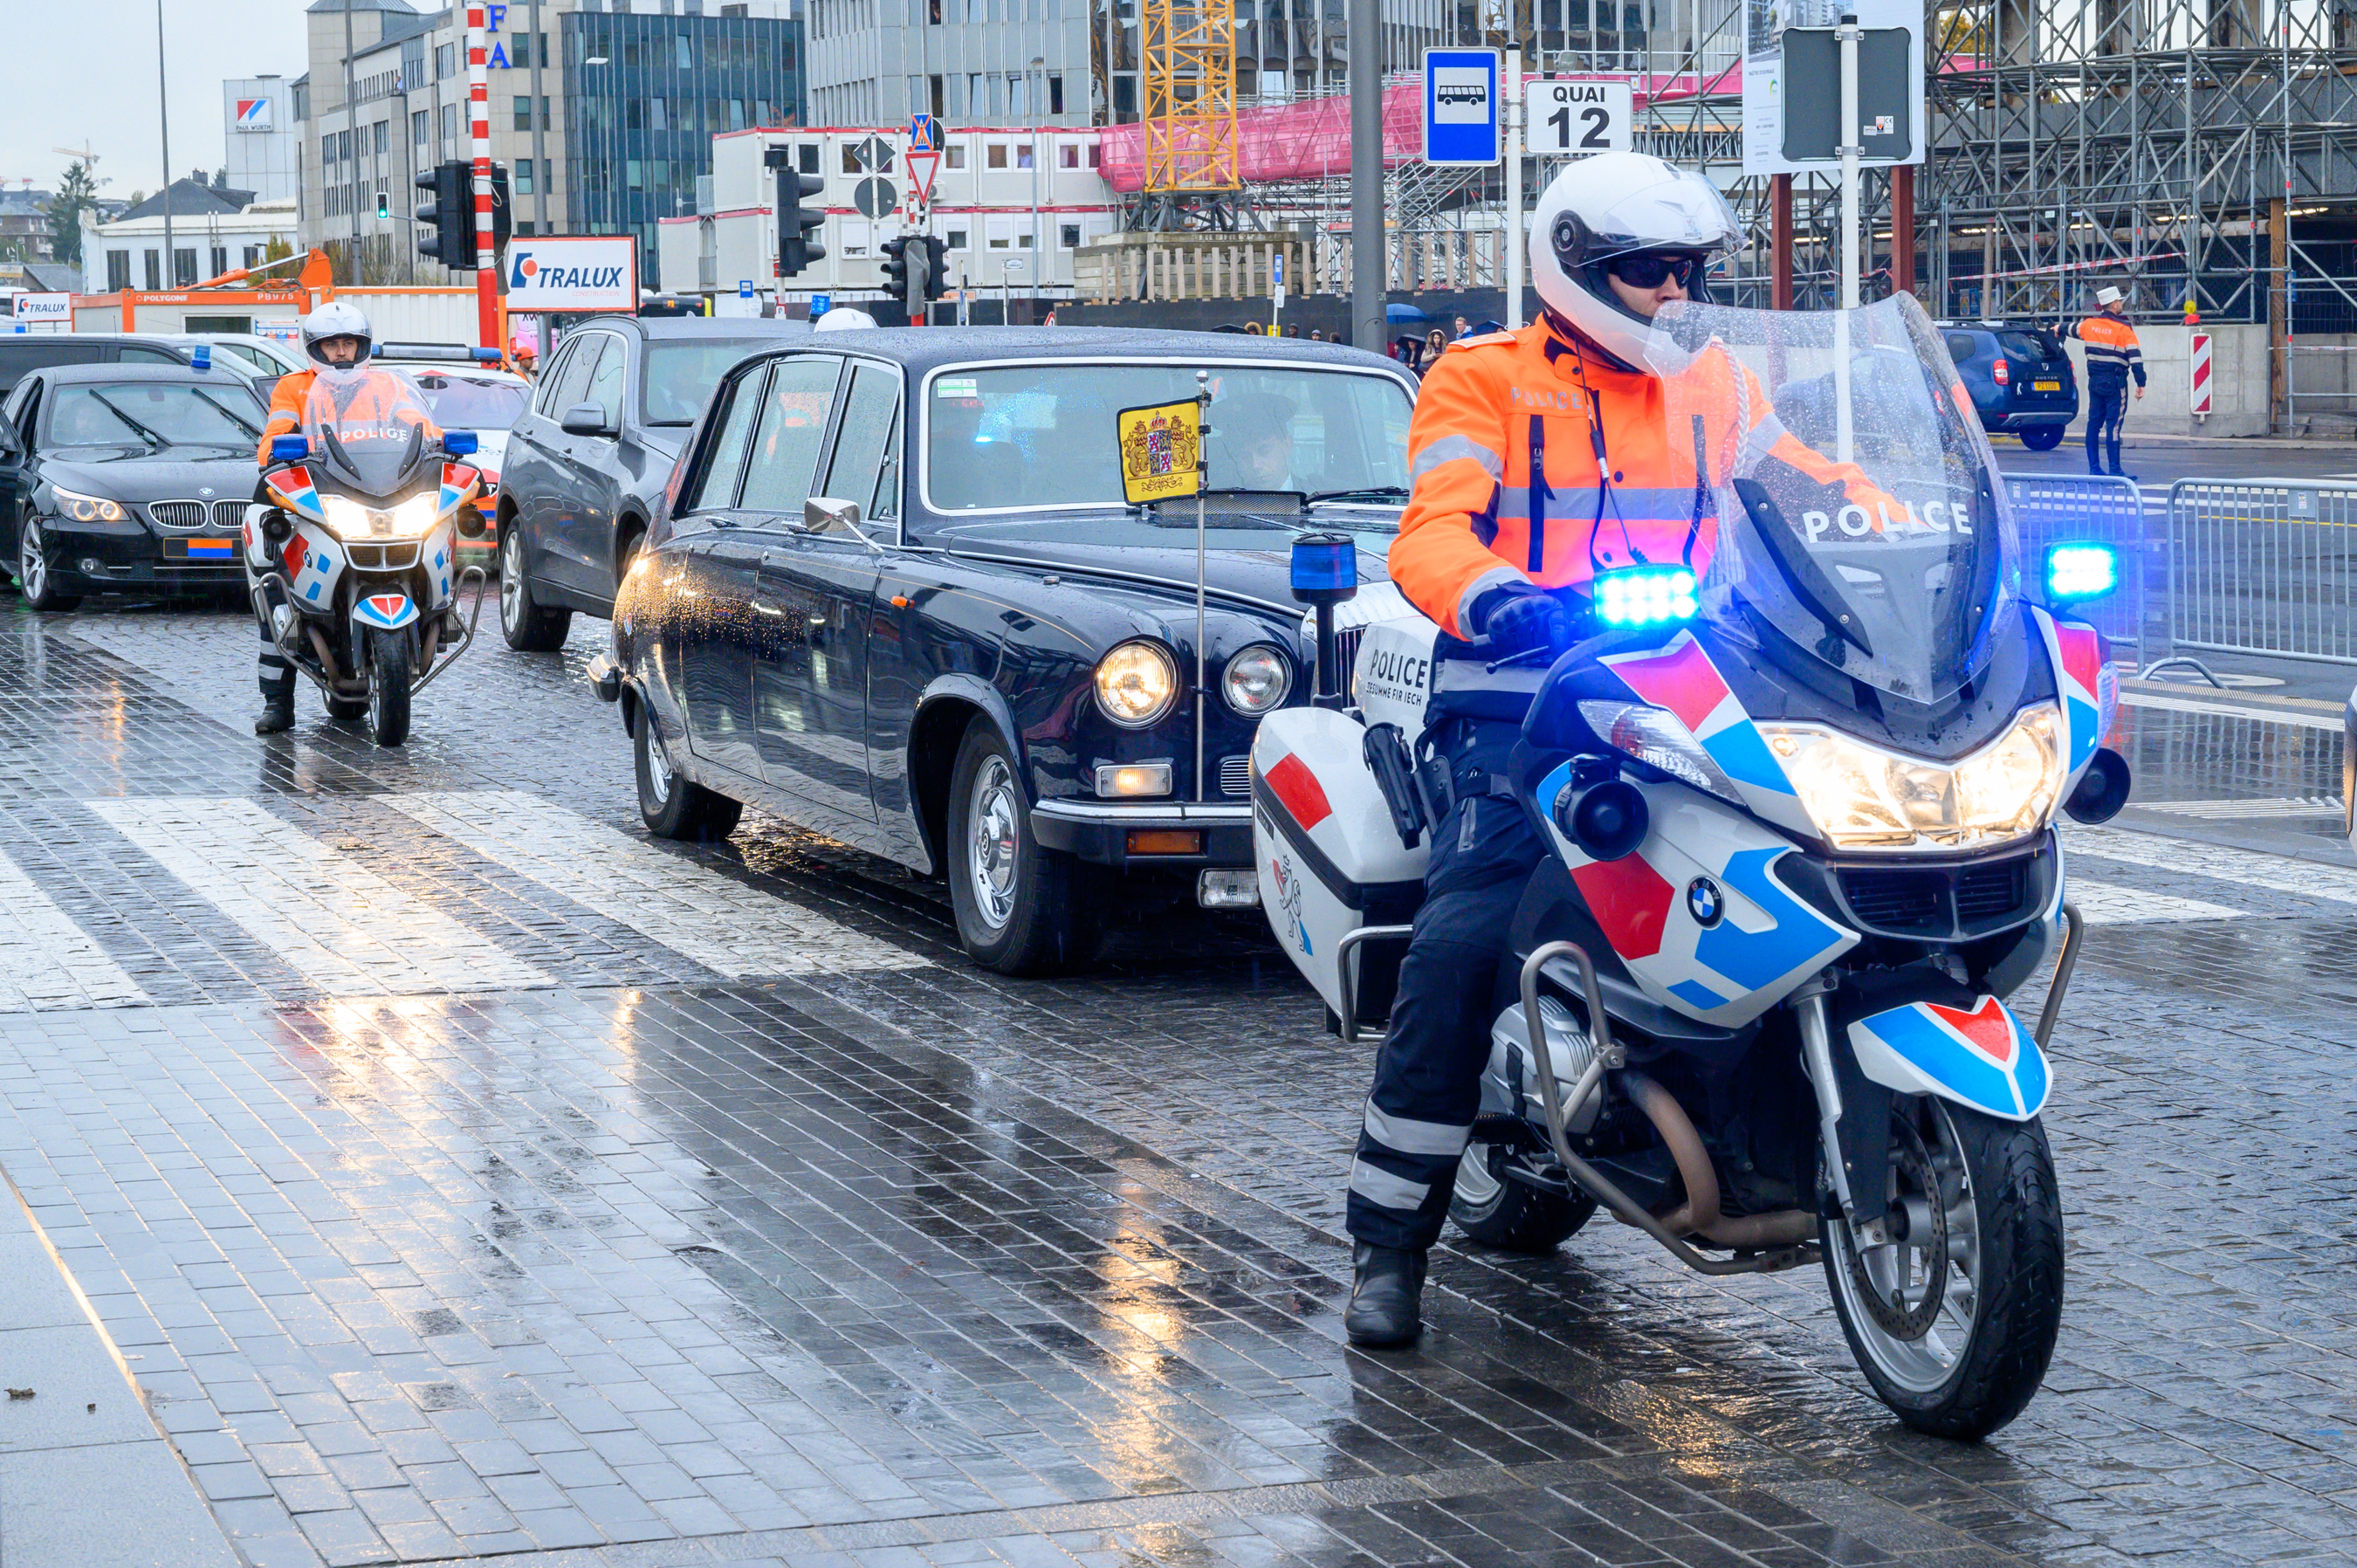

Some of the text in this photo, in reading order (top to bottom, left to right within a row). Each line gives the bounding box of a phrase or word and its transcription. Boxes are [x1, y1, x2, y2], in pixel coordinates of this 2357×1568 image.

[1553, 86, 1605, 103] QUAI
[1548, 107, 1611, 148] 12
[539, 266, 624, 288] TRALUX
[30, 303, 66, 313] TRALUX
[2091, 327, 2113, 335] POLICE
[1511, 387, 1582, 409] POLICE
[340, 427, 408, 443] POLICE
[1802, 500, 1974, 544] POLICE
[1369, 649, 1428, 689] POLICE
[1365, 681, 1422, 706] ZESUMME FIR IECH
[1691, 879, 1721, 900] BMW
